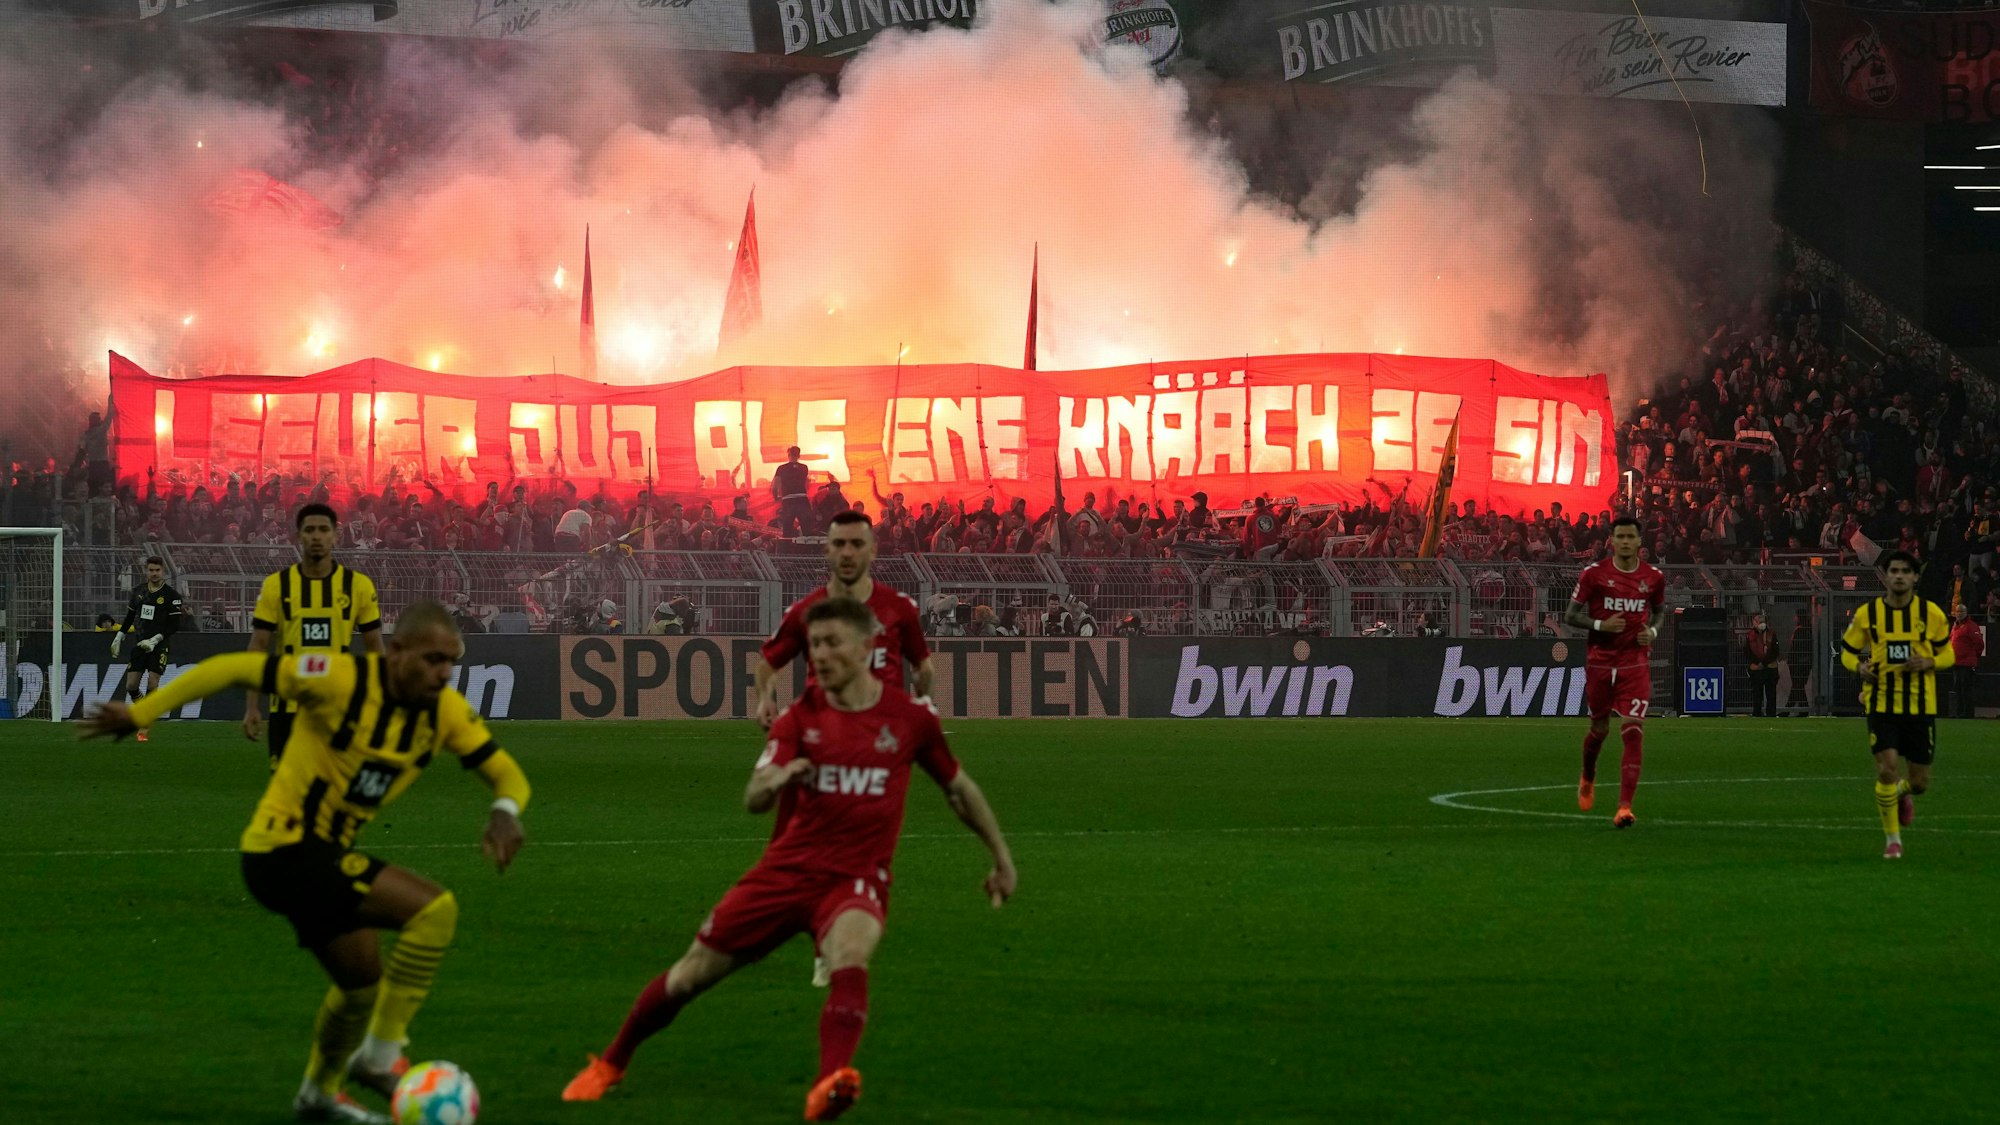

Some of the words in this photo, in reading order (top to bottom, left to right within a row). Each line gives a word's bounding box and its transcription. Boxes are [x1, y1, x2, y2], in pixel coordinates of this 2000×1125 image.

[1598, 16, 1669, 57] Bier
[1621, 52, 1663, 79] sein
[1667, 36, 1751, 74] Revier
[694, 399, 850, 488] ALS
[882, 396, 1028, 484] ENE
[1490, 396, 1603, 486] SIN
[143, 607, 154, 618] 1&1
[1604, 597, 1646, 612] REWE
[303, 623, 330, 641] 1&1
[1888, 645, 1909, 660] 1&1
[1170, 640, 1354, 717] bwin
[1688, 678, 1719, 700] 1&1
[1629, 698, 1649, 717] 27
